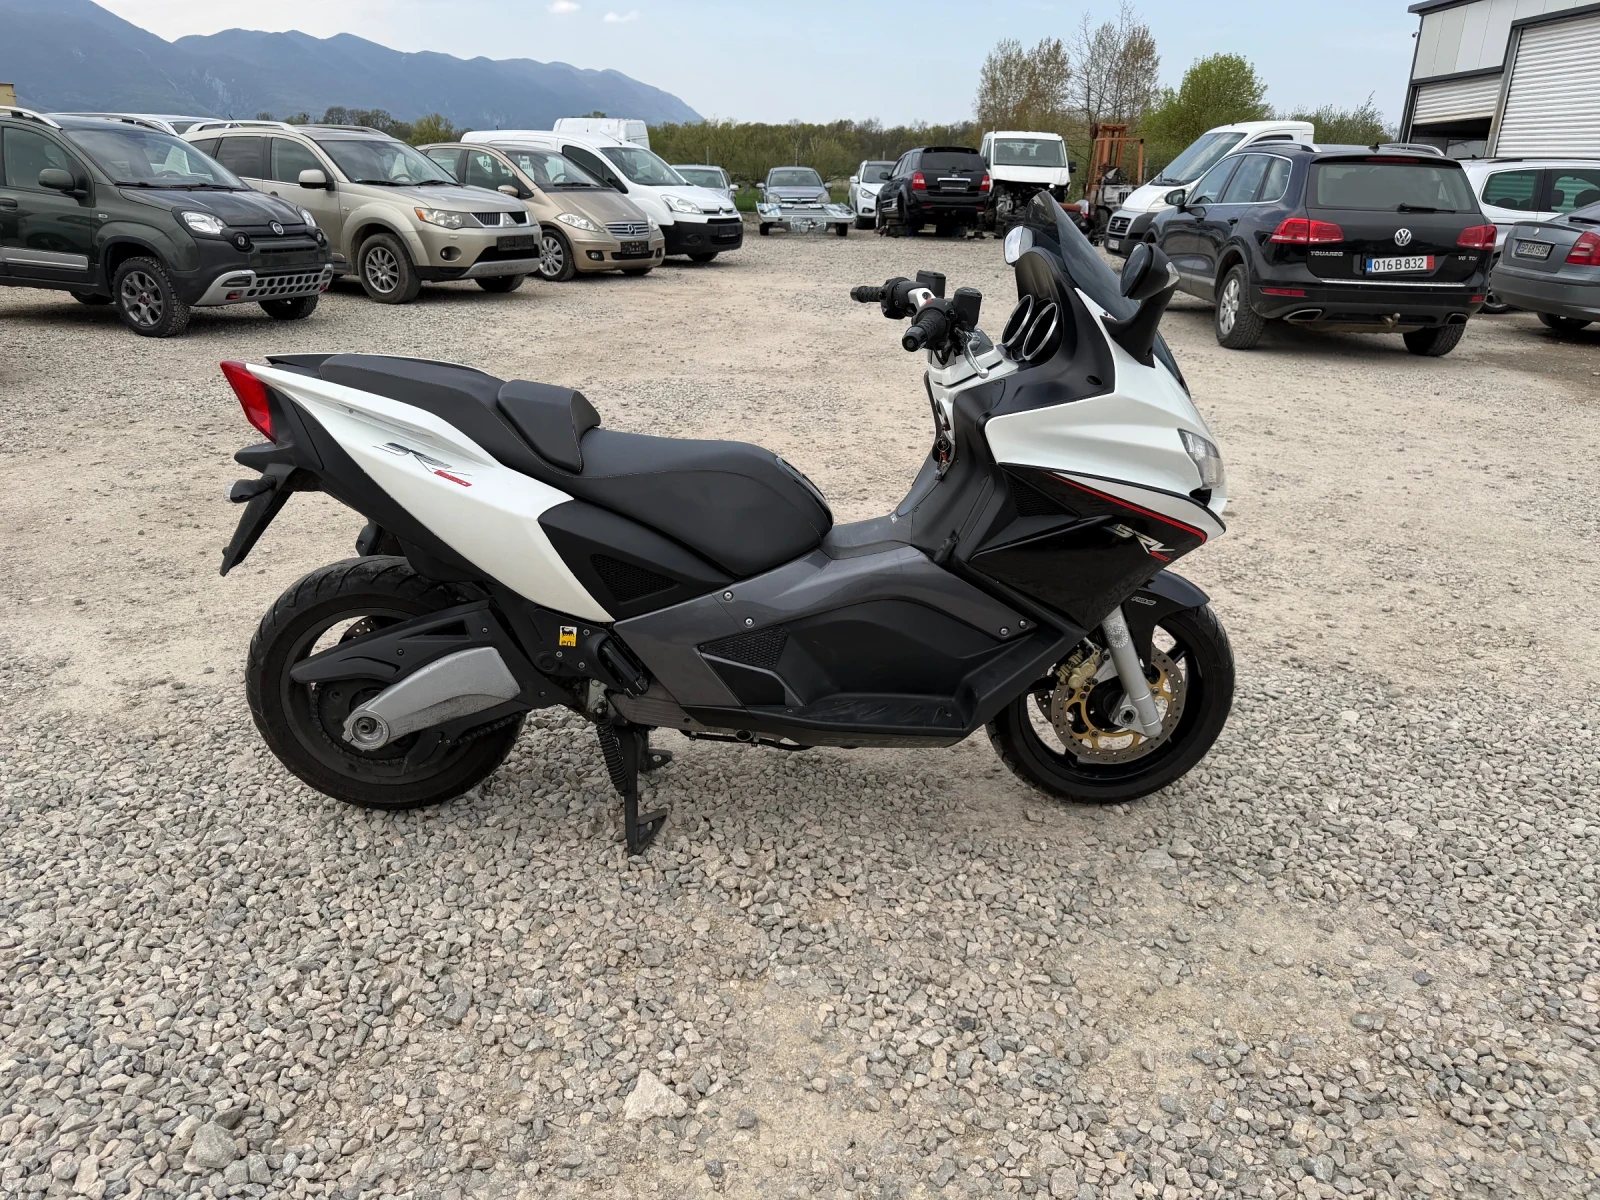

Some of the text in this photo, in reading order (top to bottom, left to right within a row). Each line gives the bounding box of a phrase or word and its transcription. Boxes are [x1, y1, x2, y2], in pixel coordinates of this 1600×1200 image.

[1373, 259, 1393, 271] 016
[1394, 258, 1405, 270] B
[1404, 257, 1424, 269] 832
